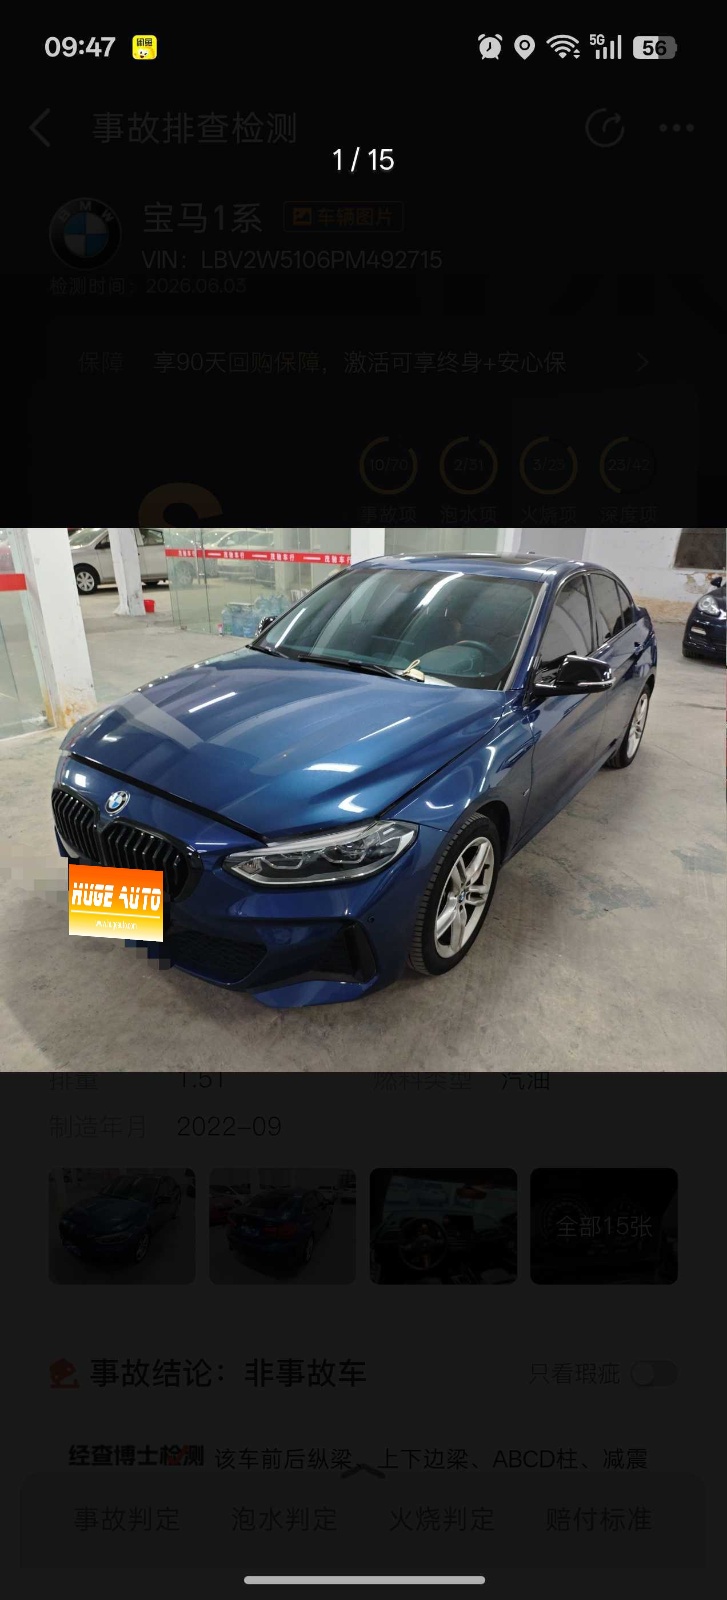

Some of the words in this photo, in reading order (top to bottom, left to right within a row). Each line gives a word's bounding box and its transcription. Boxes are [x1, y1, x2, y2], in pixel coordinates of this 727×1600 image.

[45, 37, 115, 57] 09:47
[589, 34, 605, 46] 5G
[642, 40, 667, 56] 56
[92, 111, 297, 145] 事故排查检测
[143, 201, 263, 234] 宝马1系
[316, 208, 394, 227] 车辆图片
[201, 249, 442, 269] LBV2W5106PM492715
[78, 352, 124, 375] 保障
[49, 1114, 146, 1139] 制造年月
[556, 1214, 653, 1239] 全部15张
[529, 1361, 621, 1386] 只看瑕疵
[74, 1505, 181, 1532] 事故判定
[231, 1505, 338, 1532] 泡水判定
[389, 1505, 495, 1532] 火烧判定
[546, 1505, 652, 1532] 赔付标准
